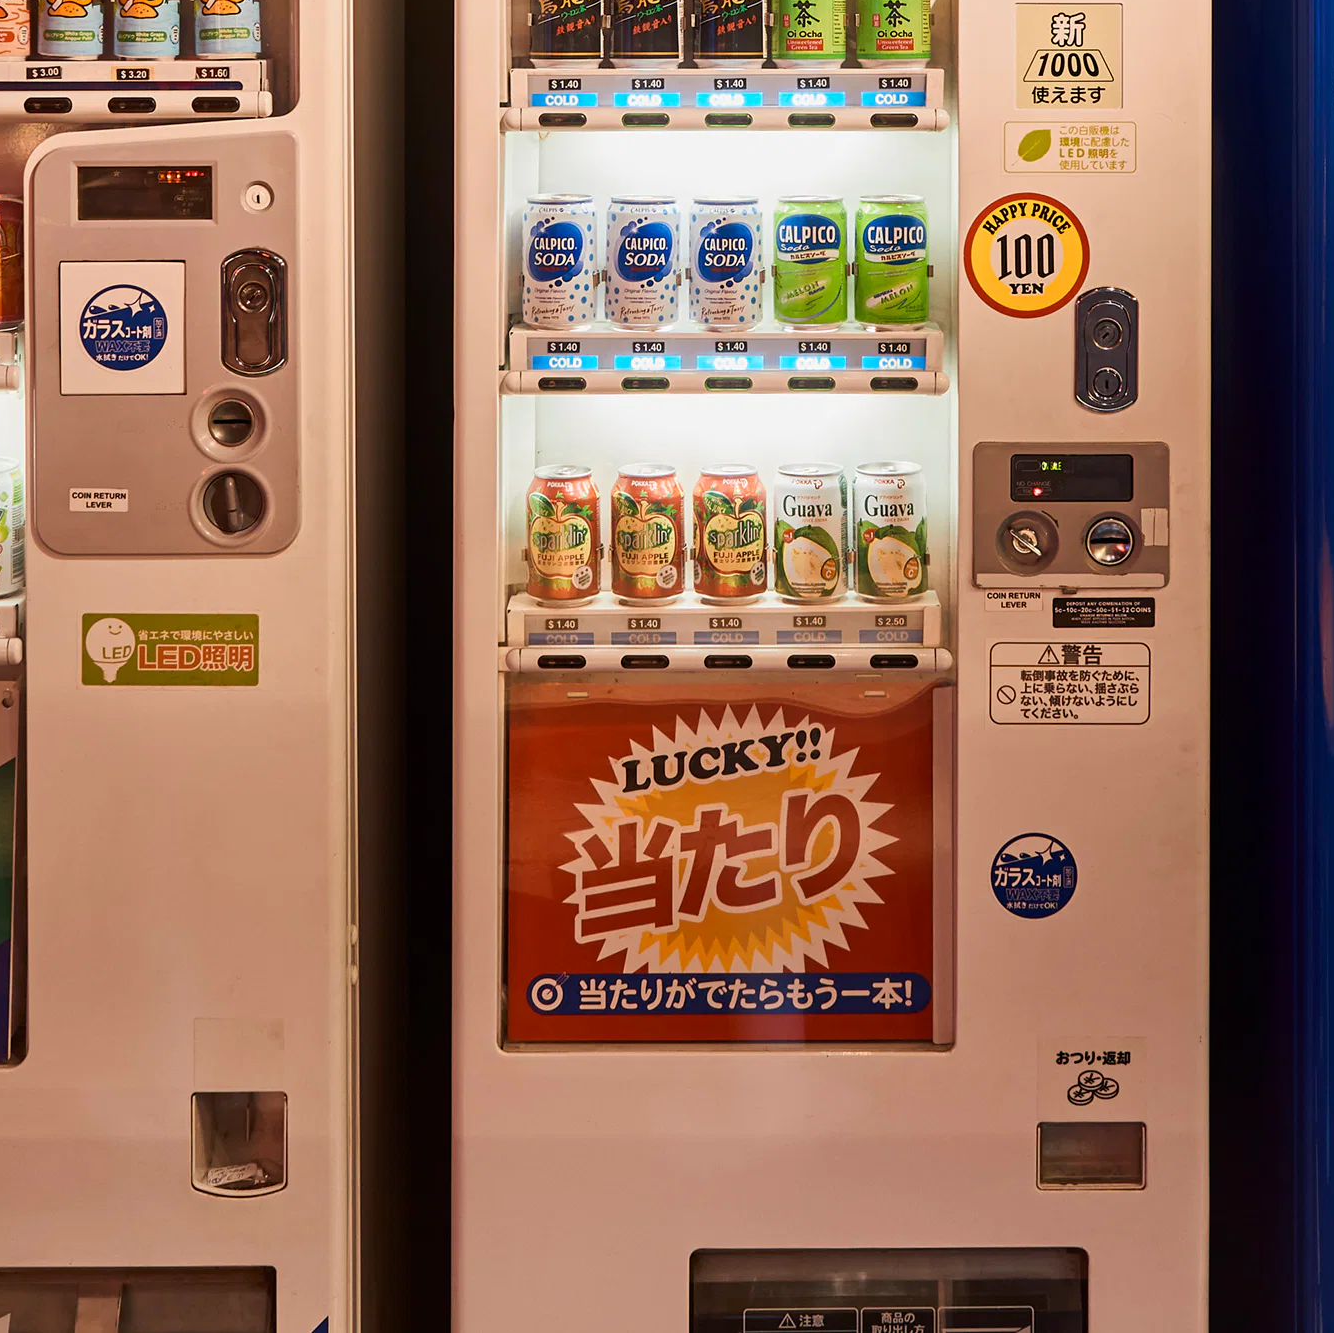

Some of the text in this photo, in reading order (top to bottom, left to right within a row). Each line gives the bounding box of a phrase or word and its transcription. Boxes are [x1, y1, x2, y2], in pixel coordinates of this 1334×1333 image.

[787, 30, 823, 38] Oi Ocha
[1050, 12, 1086, 47] 新
[1037, 52, 1100, 78] 1000
[544, 94, 579, 107] COLD
[875, 92, 909, 105] COLD
[1031, 86, 1106, 105] 使えます
[982, 201, 1072, 236] HAPPY PRICE
[778, 225, 836, 244] CALPICO
[867, 226, 924, 244] CALPICO
[534, 237, 576, 251] CALPICO
[780, 244, 810, 252] Soda
[533, 253, 576, 267] SODA
[704, 253, 746, 267] SODA
[997, 232, 1056, 281] 100
[786, 280, 820, 300] MELON
[1008, 282, 1045, 295] YEN
[549, 356, 583, 369] COLD
[878, 357, 912, 370] COLD
[94, 491, 127, 499] RETURN
[86, 501, 113, 509] LEVER
[783, 494, 833, 518] Guava
[864, 494, 914, 518] Guava
[537, 553, 585, 562] FUJI APPLE
[987, 592, 1041, 600] COIN RETURN
[1001, 601, 1028, 609] LEVER
[137, 630, 255, 642] 省エネで環境にやさしい
[545, 632, 579, 645] COLD
[875, 630, 910, 642] COLD
[102, 644, 132, 660] LED
[137, 643, 255, 672] LED照明
[1061, 644, 1103, 666] 警告
[1021, 707, 1079, 720] てください。
[620, 726, 823, 794] LUCKY!!
[575, 788, 862, 944] 当たり
[799, 1314, 825, 1329] 注意
[881, 1311, 916, 1324] 商品の
